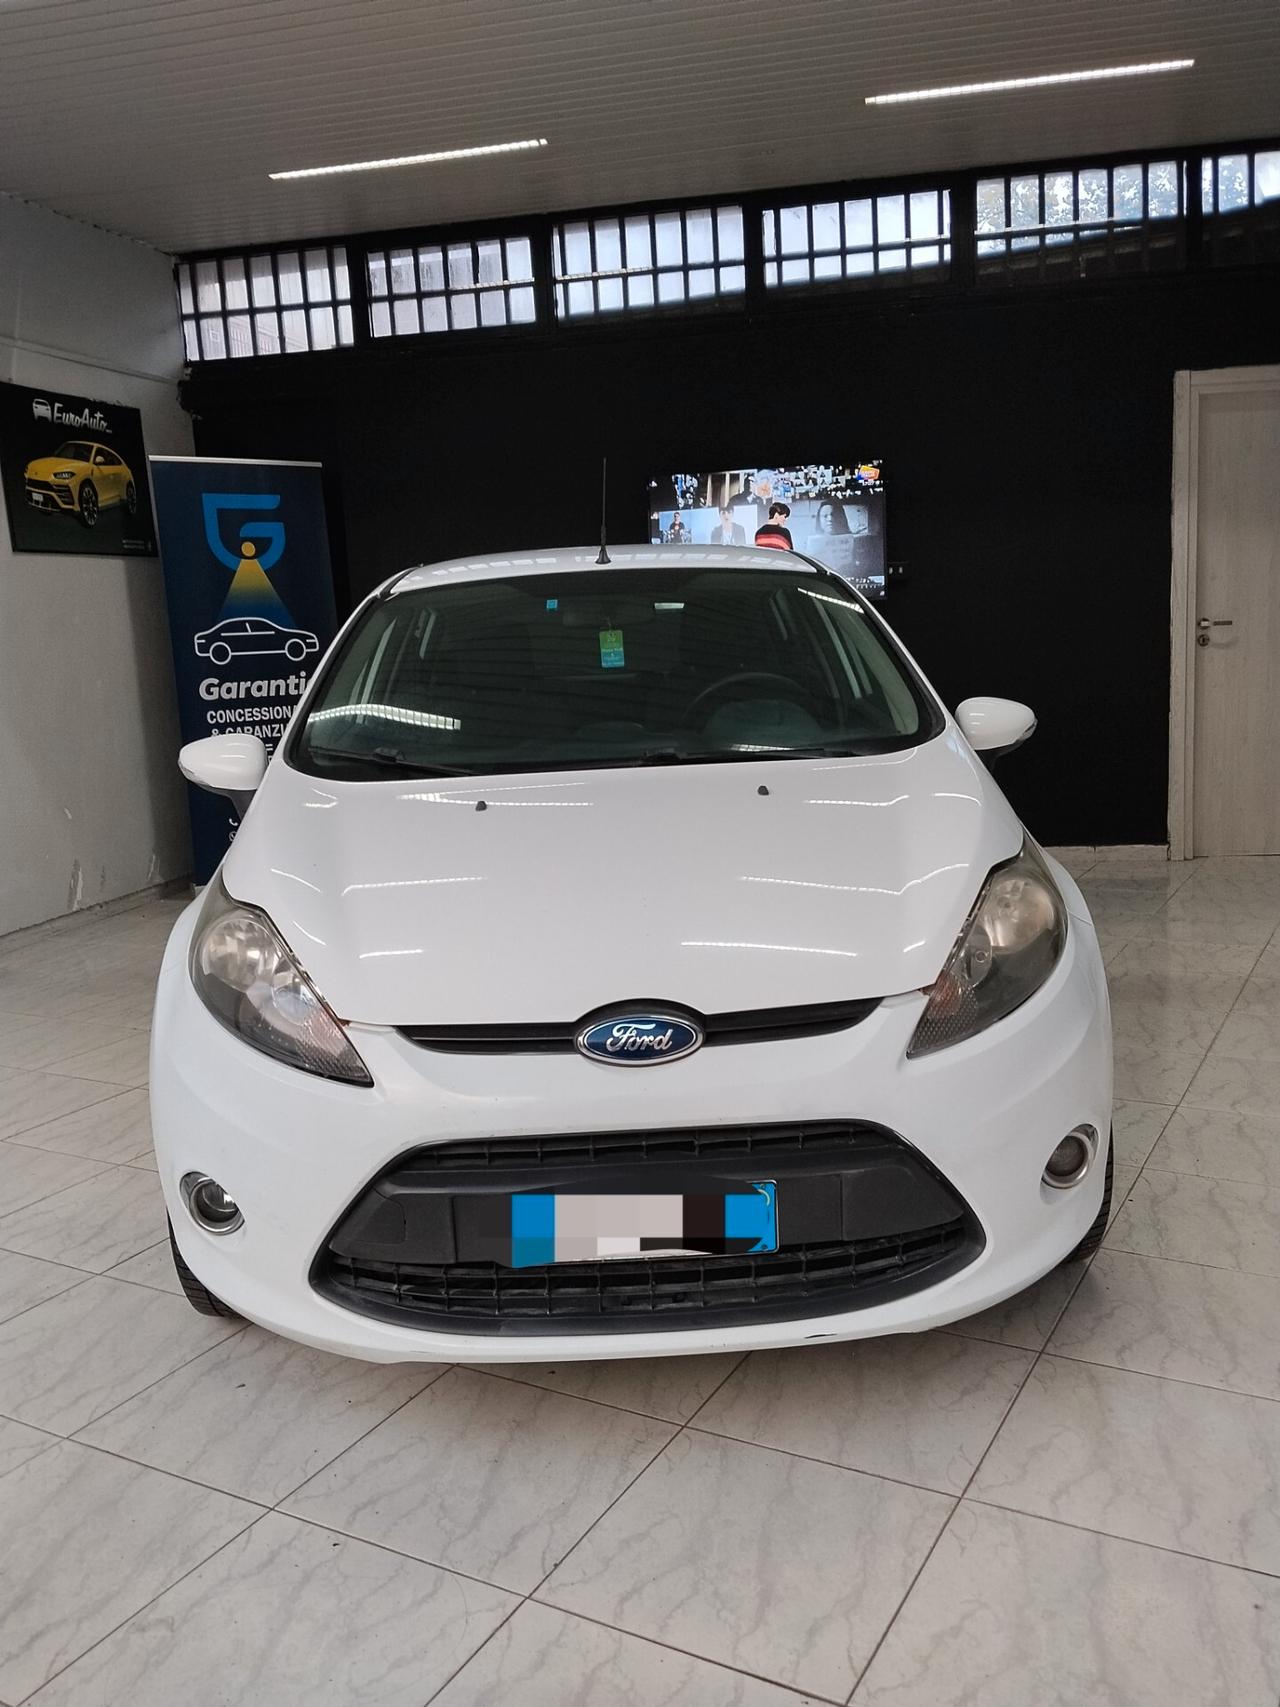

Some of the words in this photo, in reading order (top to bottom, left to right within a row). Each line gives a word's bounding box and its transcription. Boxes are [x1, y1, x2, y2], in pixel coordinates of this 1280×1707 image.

[53, 402, 108, 432] EuroAuto
[199, 670, 310, 701] Garanti
[225, 723, 289, 738] GARANZI
[606, 1023, 673, 1052] Ford
